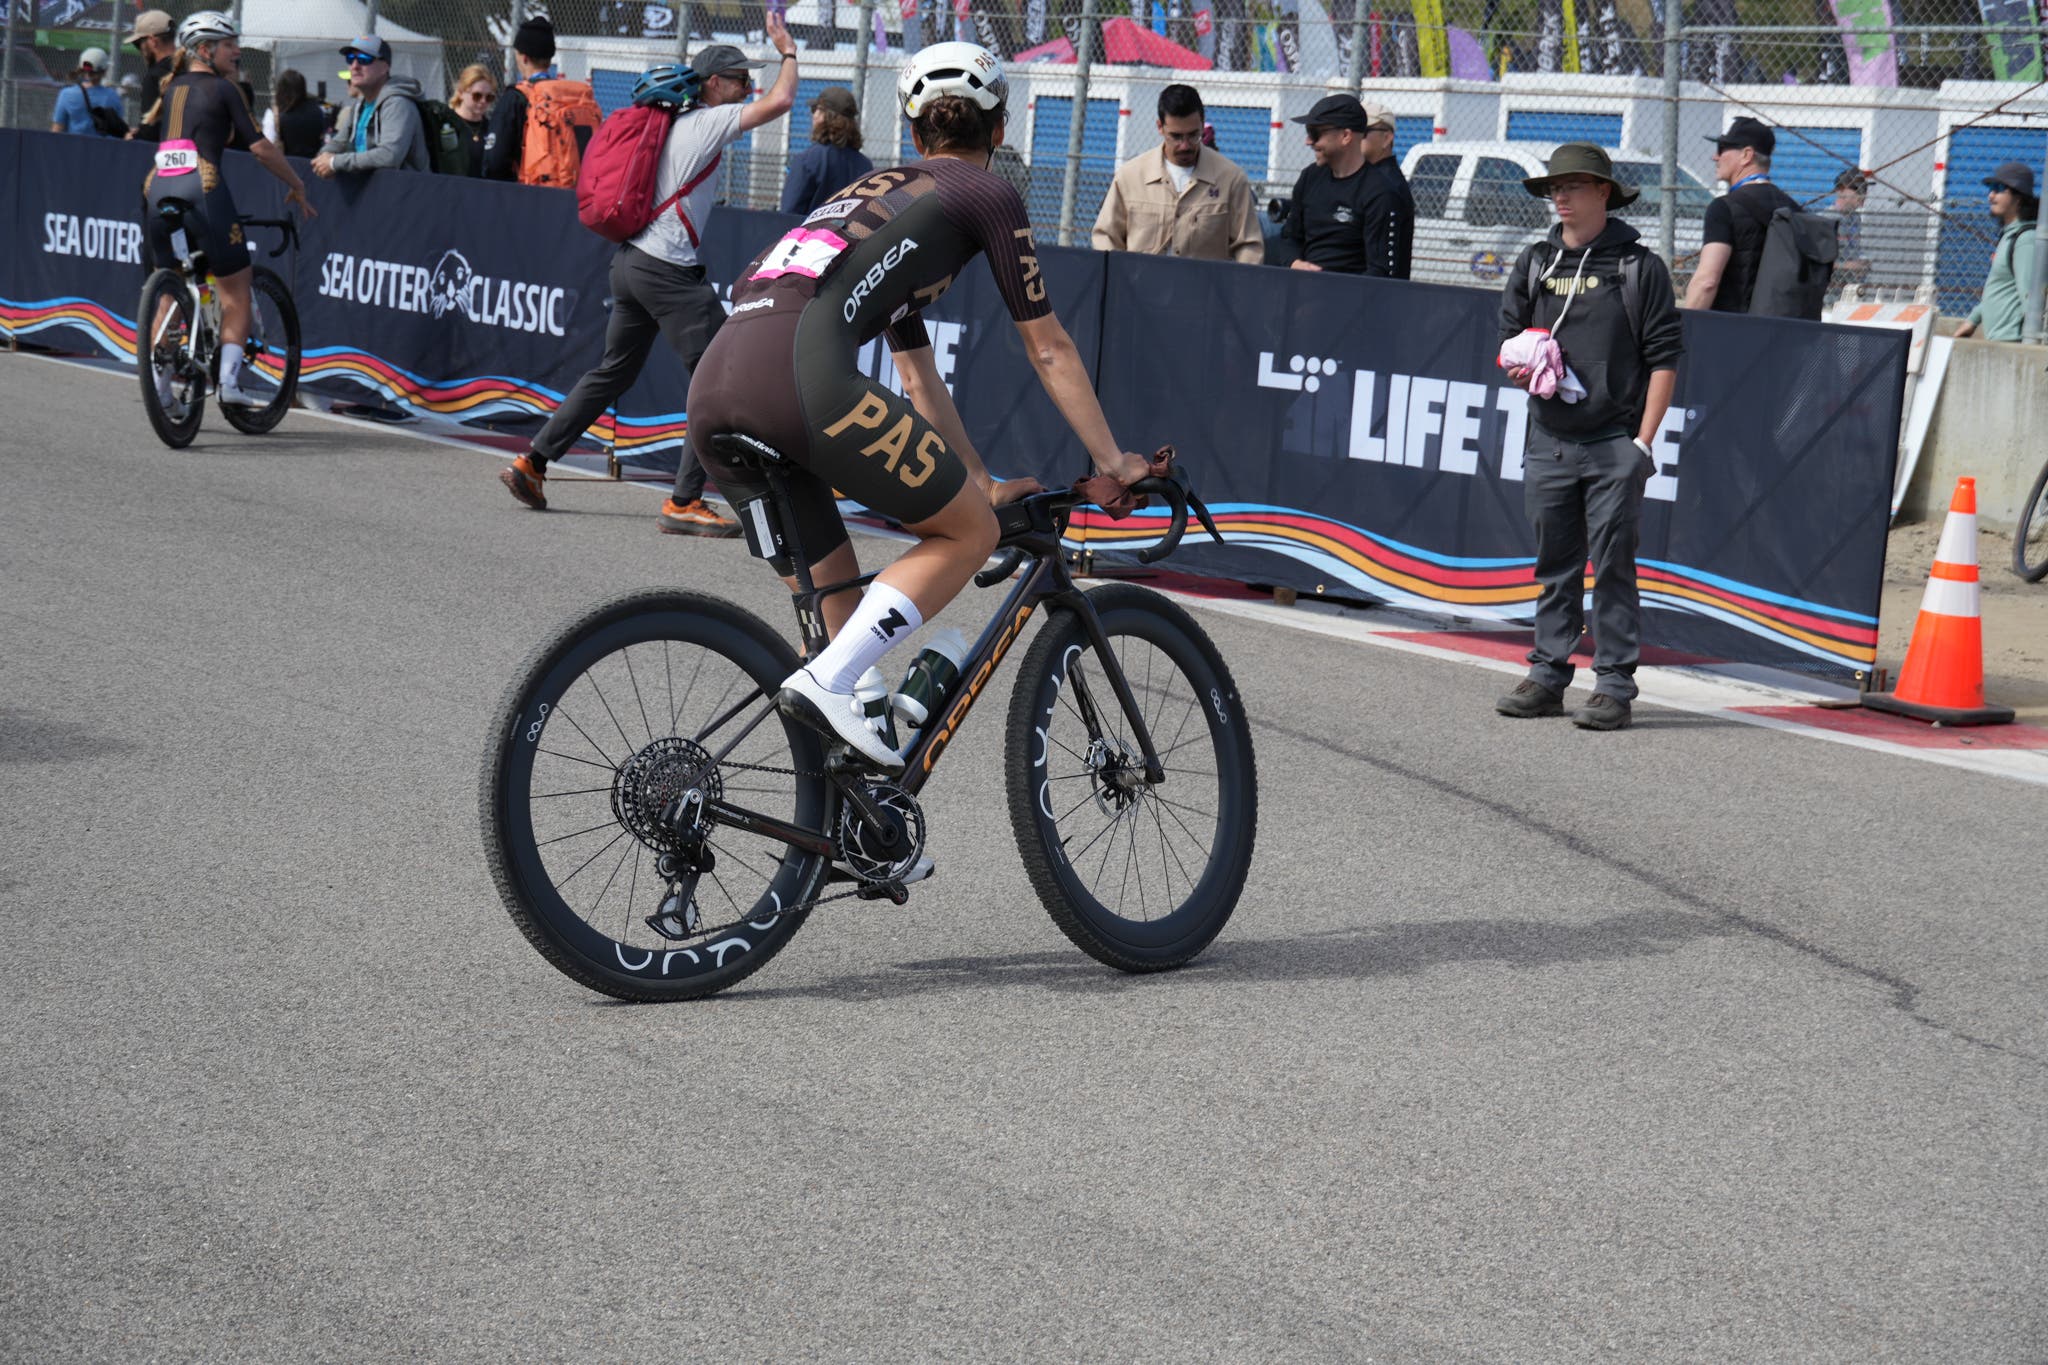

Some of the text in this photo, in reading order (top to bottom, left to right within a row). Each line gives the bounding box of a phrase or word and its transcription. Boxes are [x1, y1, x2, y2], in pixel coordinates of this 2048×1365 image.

[164, 152, 187, 167] 260
[43, 212, 141, 264] SEA OTTER
[319, 252, 565, 336] SEA OTTER CLASSIC
[844, 238, 918, 323] ORBEA
[822, 390, 946, 488] PAS
[1348, 369, 1686, 501] LIFE TE
[776, 533, 783, 546] 5
